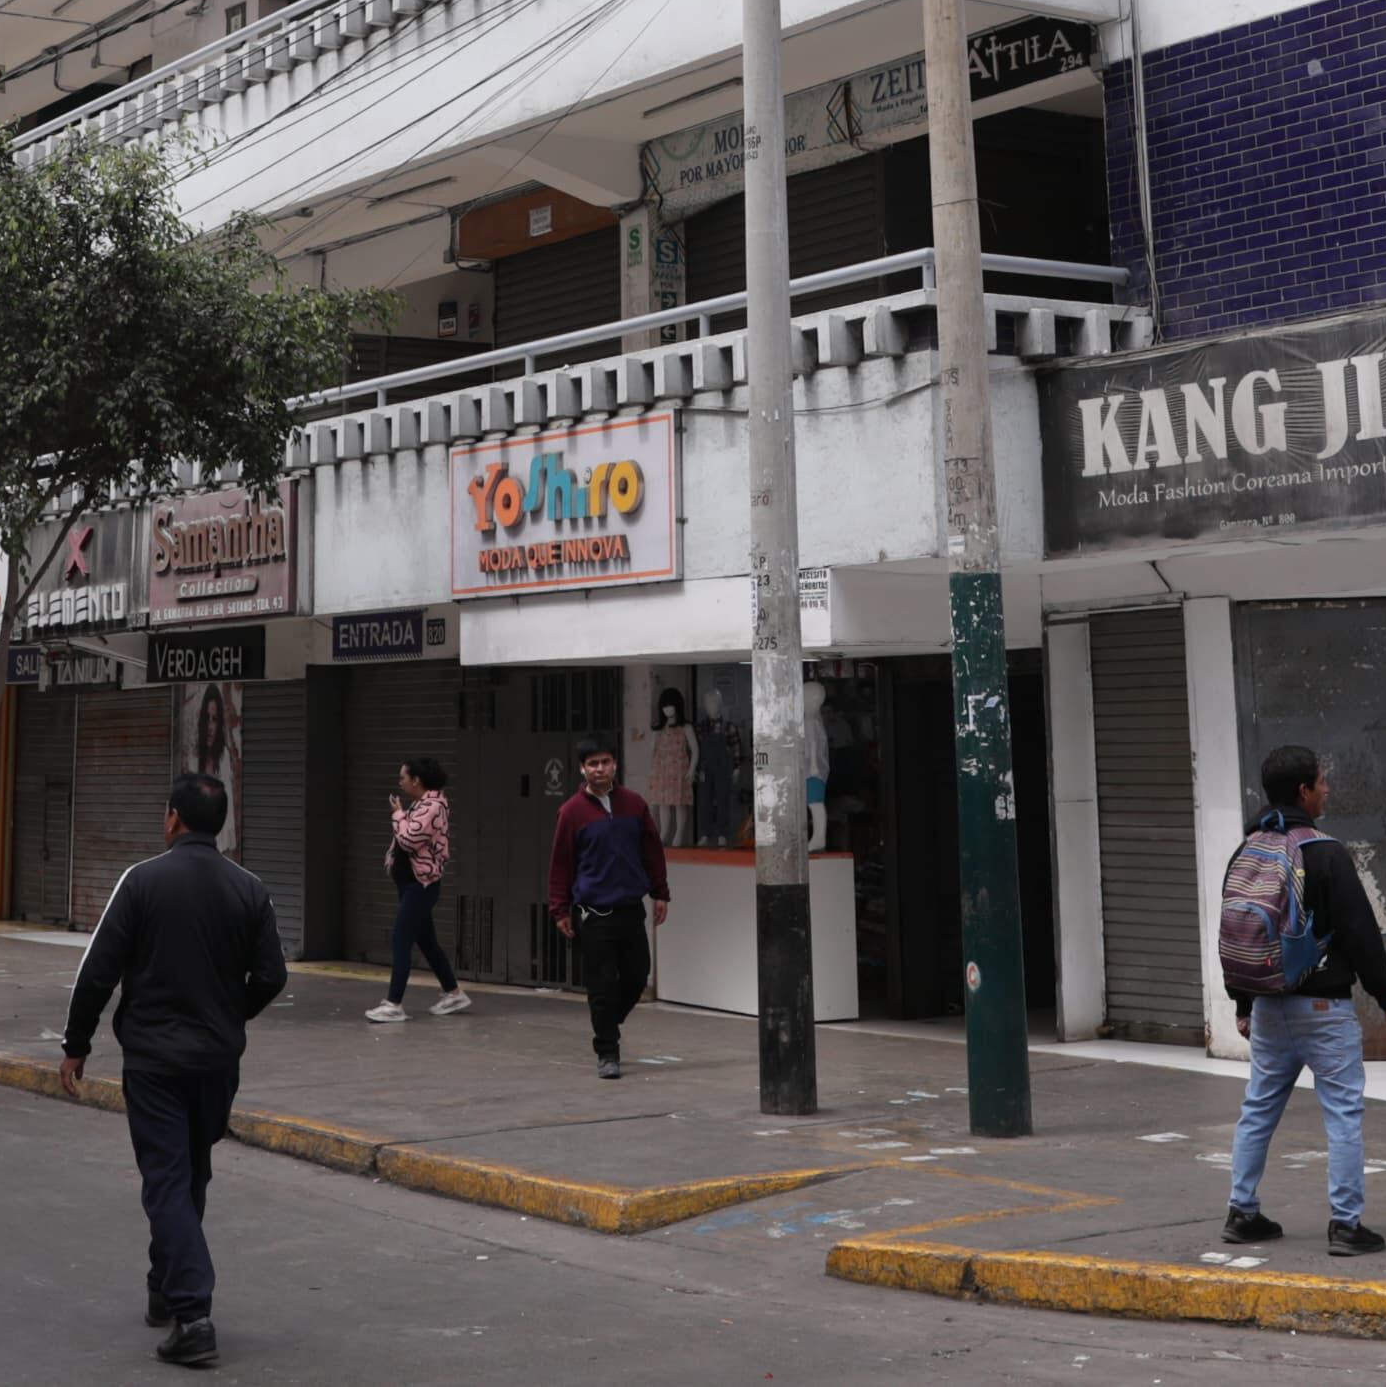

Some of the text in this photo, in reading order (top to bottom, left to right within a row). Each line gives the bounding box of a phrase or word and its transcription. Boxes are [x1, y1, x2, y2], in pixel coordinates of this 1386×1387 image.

[679, 167, 703, 186] POR
[1077, 368, 1289, 477] KANG
[468, 452, 643, 532] Yoshiro
[1098, 489, 1149, 509] Moda
[1231, 469, 1313, 492] Coreana
[153, 492, 287, 577] Samantha
[479, 534, 628, 574] MODA QUE INNOVA
[27, 582, 128, 630] ELEMENTO
[179, 576, 251, 599] Collection
[338, 619, 416, 650] ENTRADA
[427, 624, 446, 646] 820
[154, 641, 243, 679] VERDAGEH
